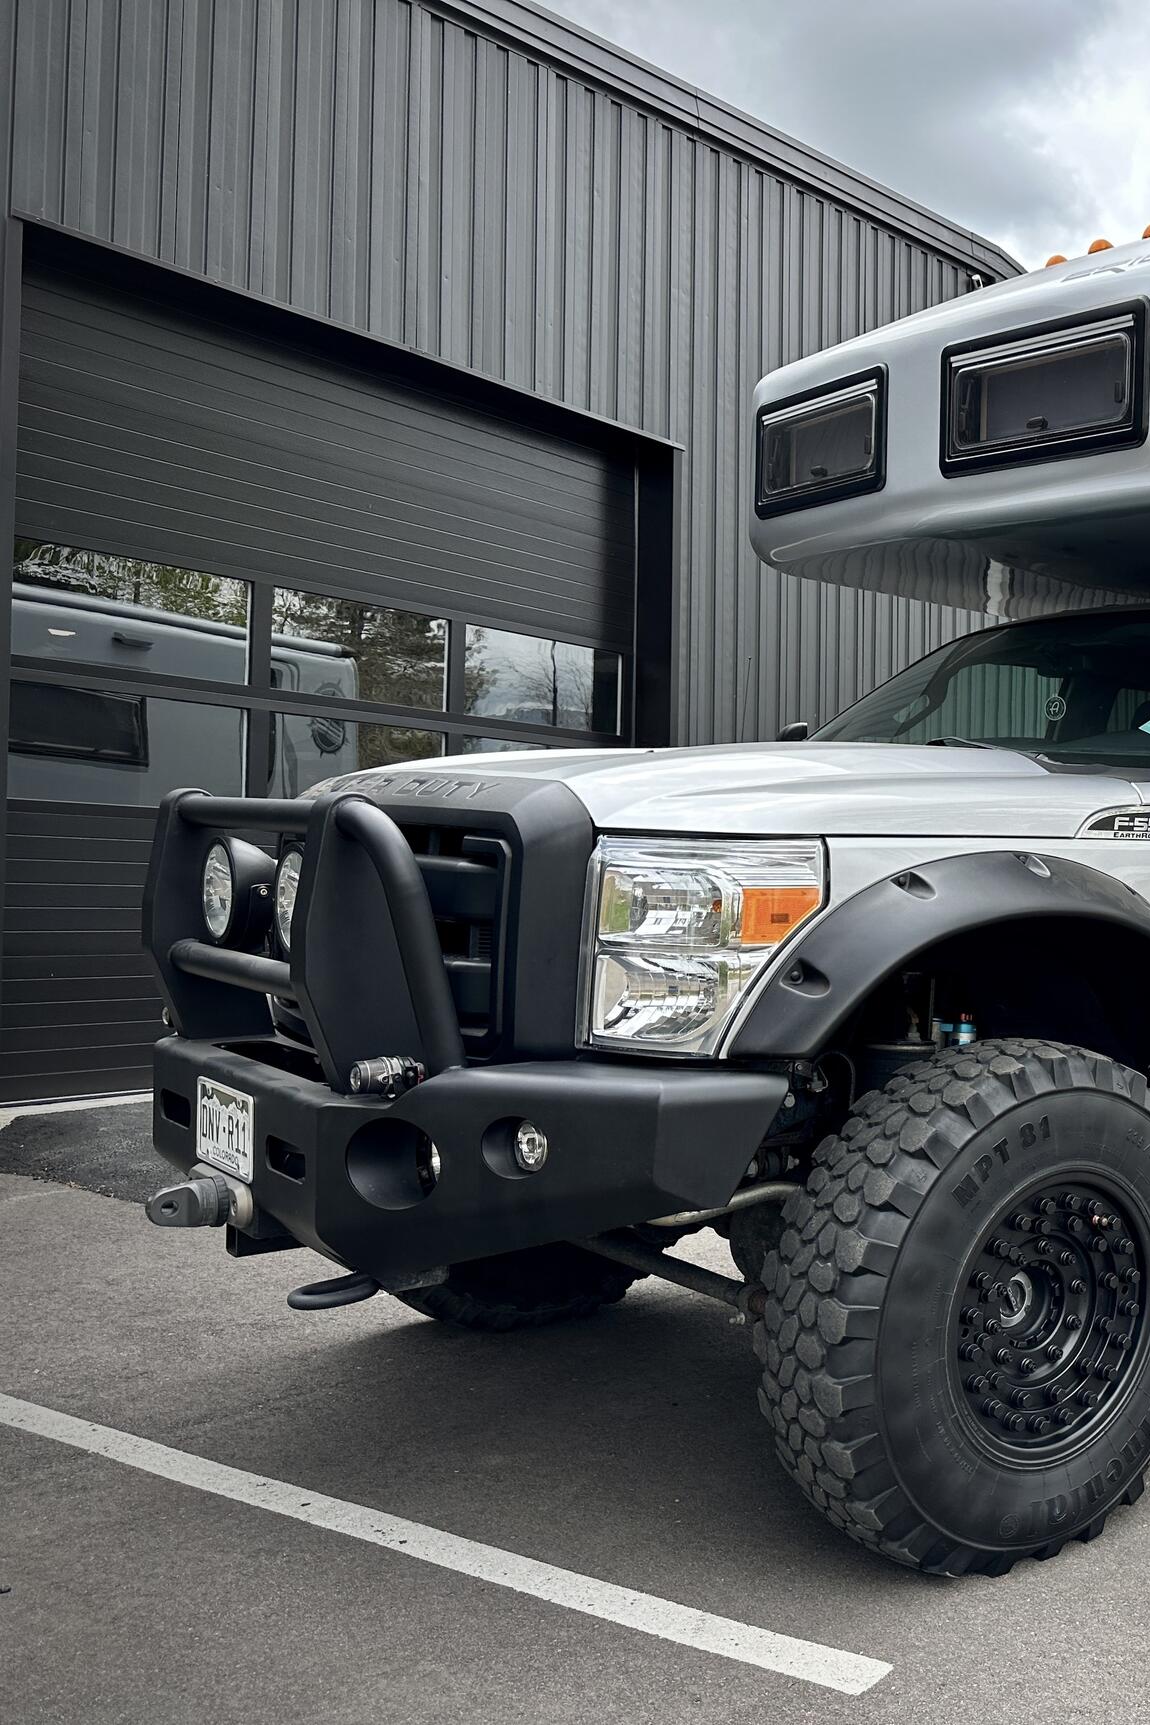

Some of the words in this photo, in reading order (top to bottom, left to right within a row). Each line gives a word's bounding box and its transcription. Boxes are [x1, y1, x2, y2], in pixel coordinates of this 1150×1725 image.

[391, 777, 500, 800] DUTY
[212, 1146, 240, 1165] COLORADO
[951, 1136, 1010, 1208] MPT
[1019, 1113, 1050, 1150] 81
